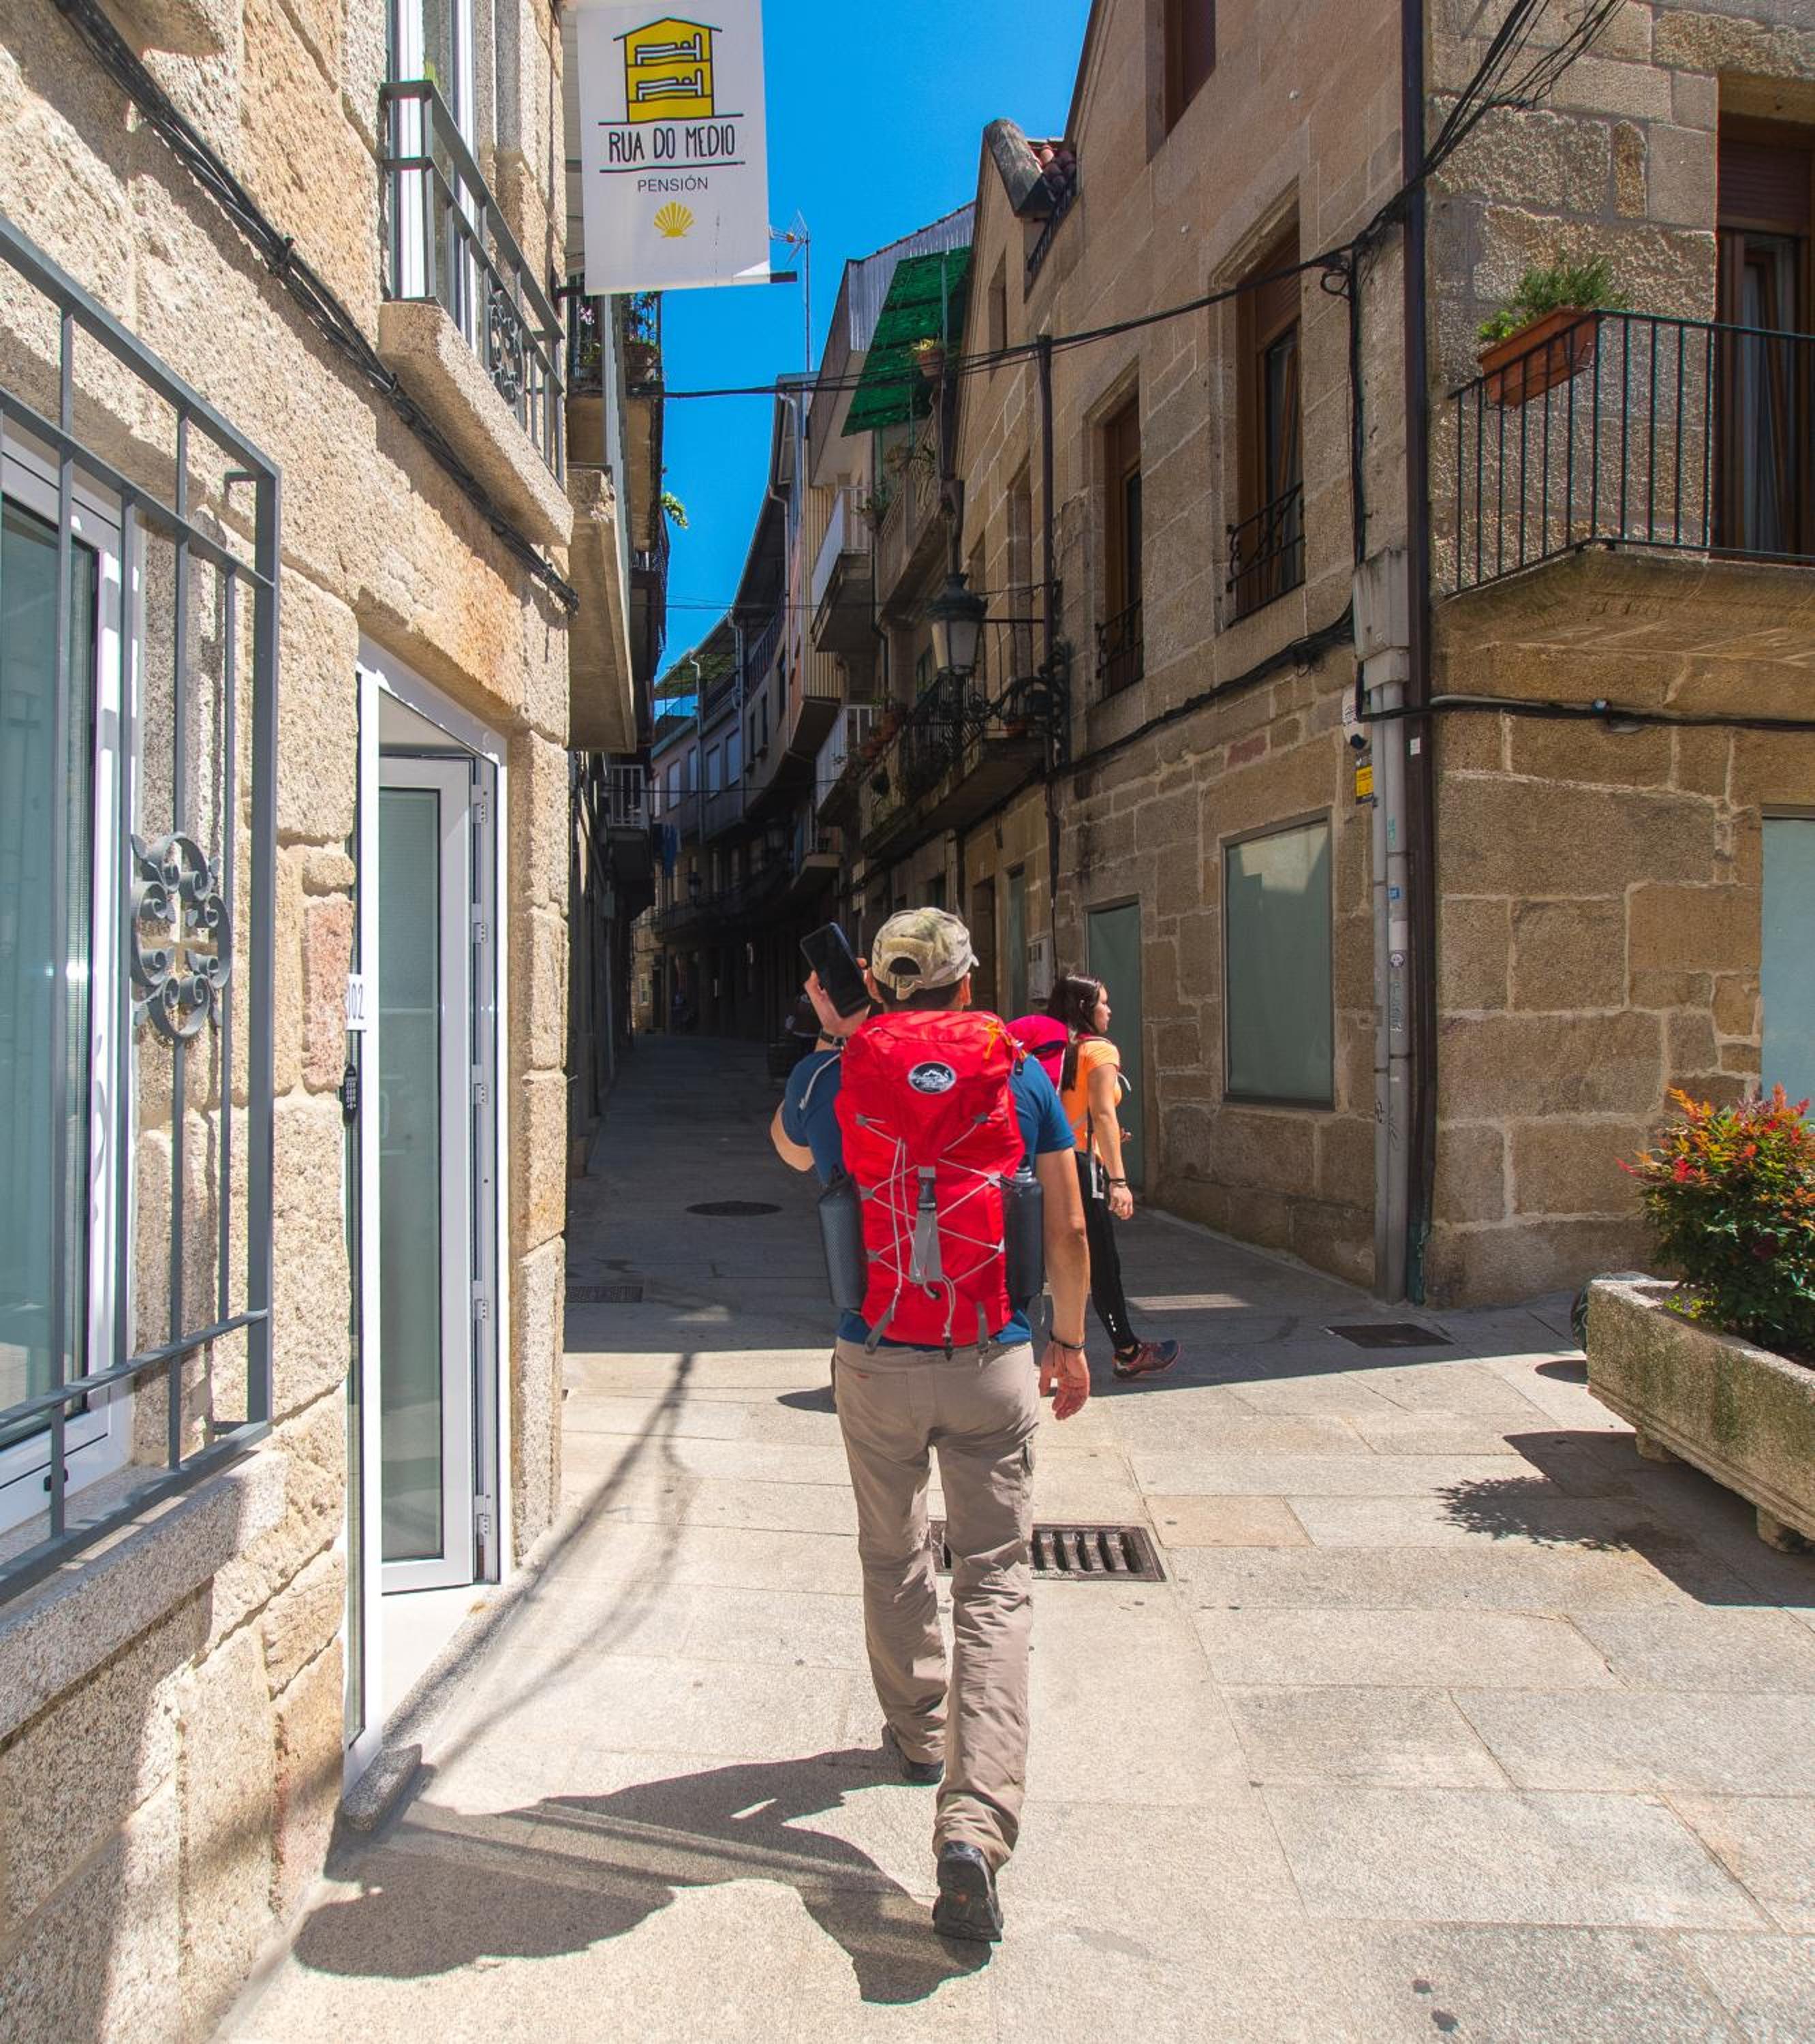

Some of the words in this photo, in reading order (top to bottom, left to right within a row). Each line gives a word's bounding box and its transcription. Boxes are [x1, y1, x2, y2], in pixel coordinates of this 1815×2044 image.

[609, 131, 645, 163] RUA
[653, 127, 675, 159] DO
[686, 125, 735, 158] MEDIO
[638, 176, 708, 192] PENSIÓN
